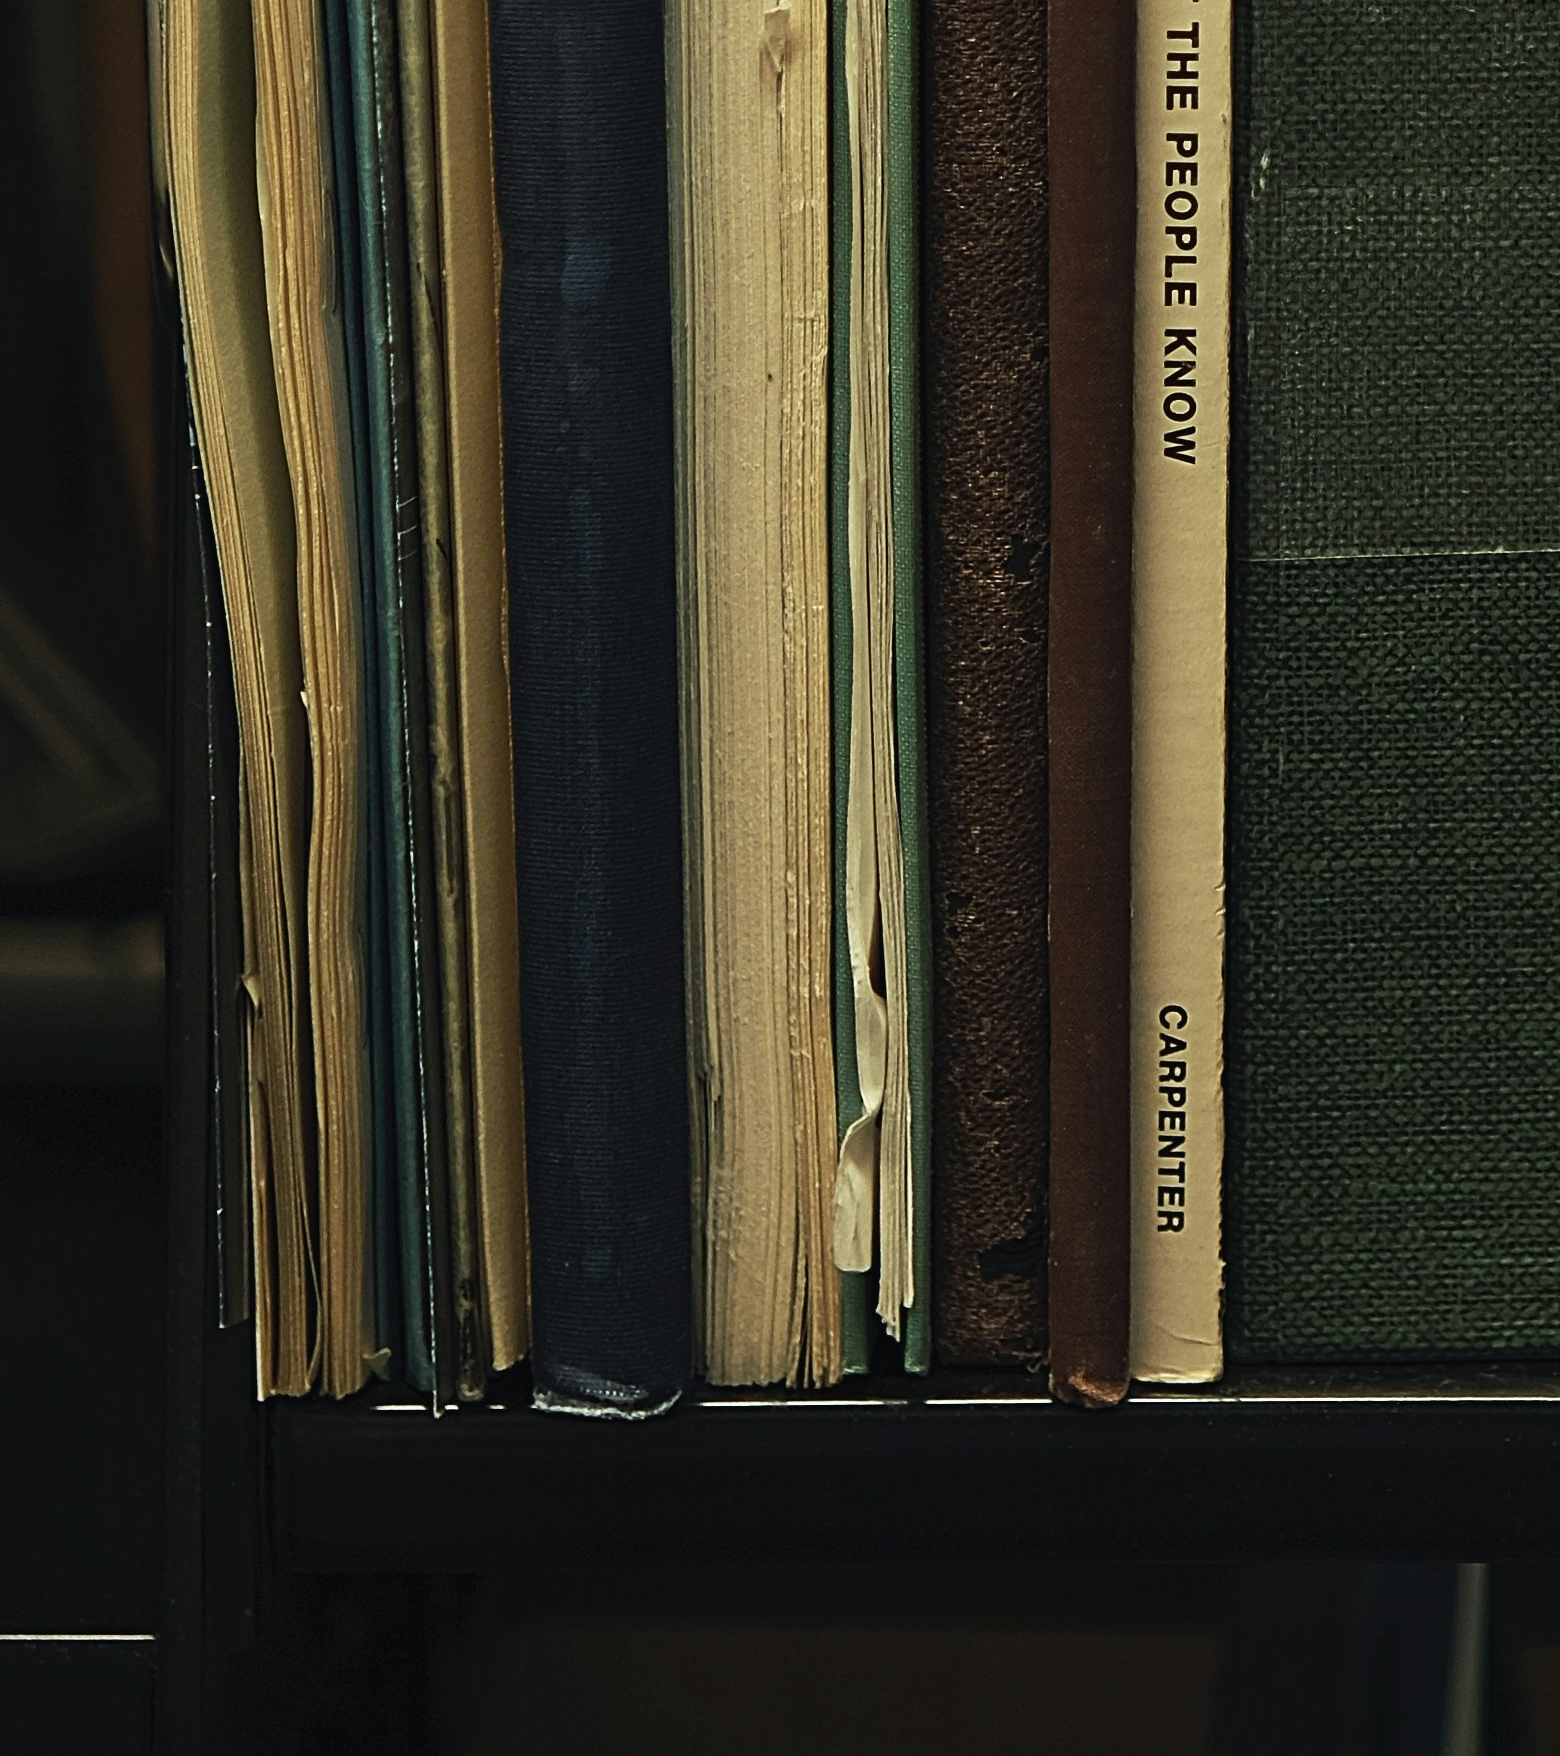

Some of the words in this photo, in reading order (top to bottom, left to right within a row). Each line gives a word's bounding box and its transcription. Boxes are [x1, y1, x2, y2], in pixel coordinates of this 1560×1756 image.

[1166, 22, 1200, 111] THE
[1164, 133, 1199, 308] PEOPLE
[1163, 327, 1198, 466] KNOW
[1157, 1004, 1188, 1234] CARPENTER
